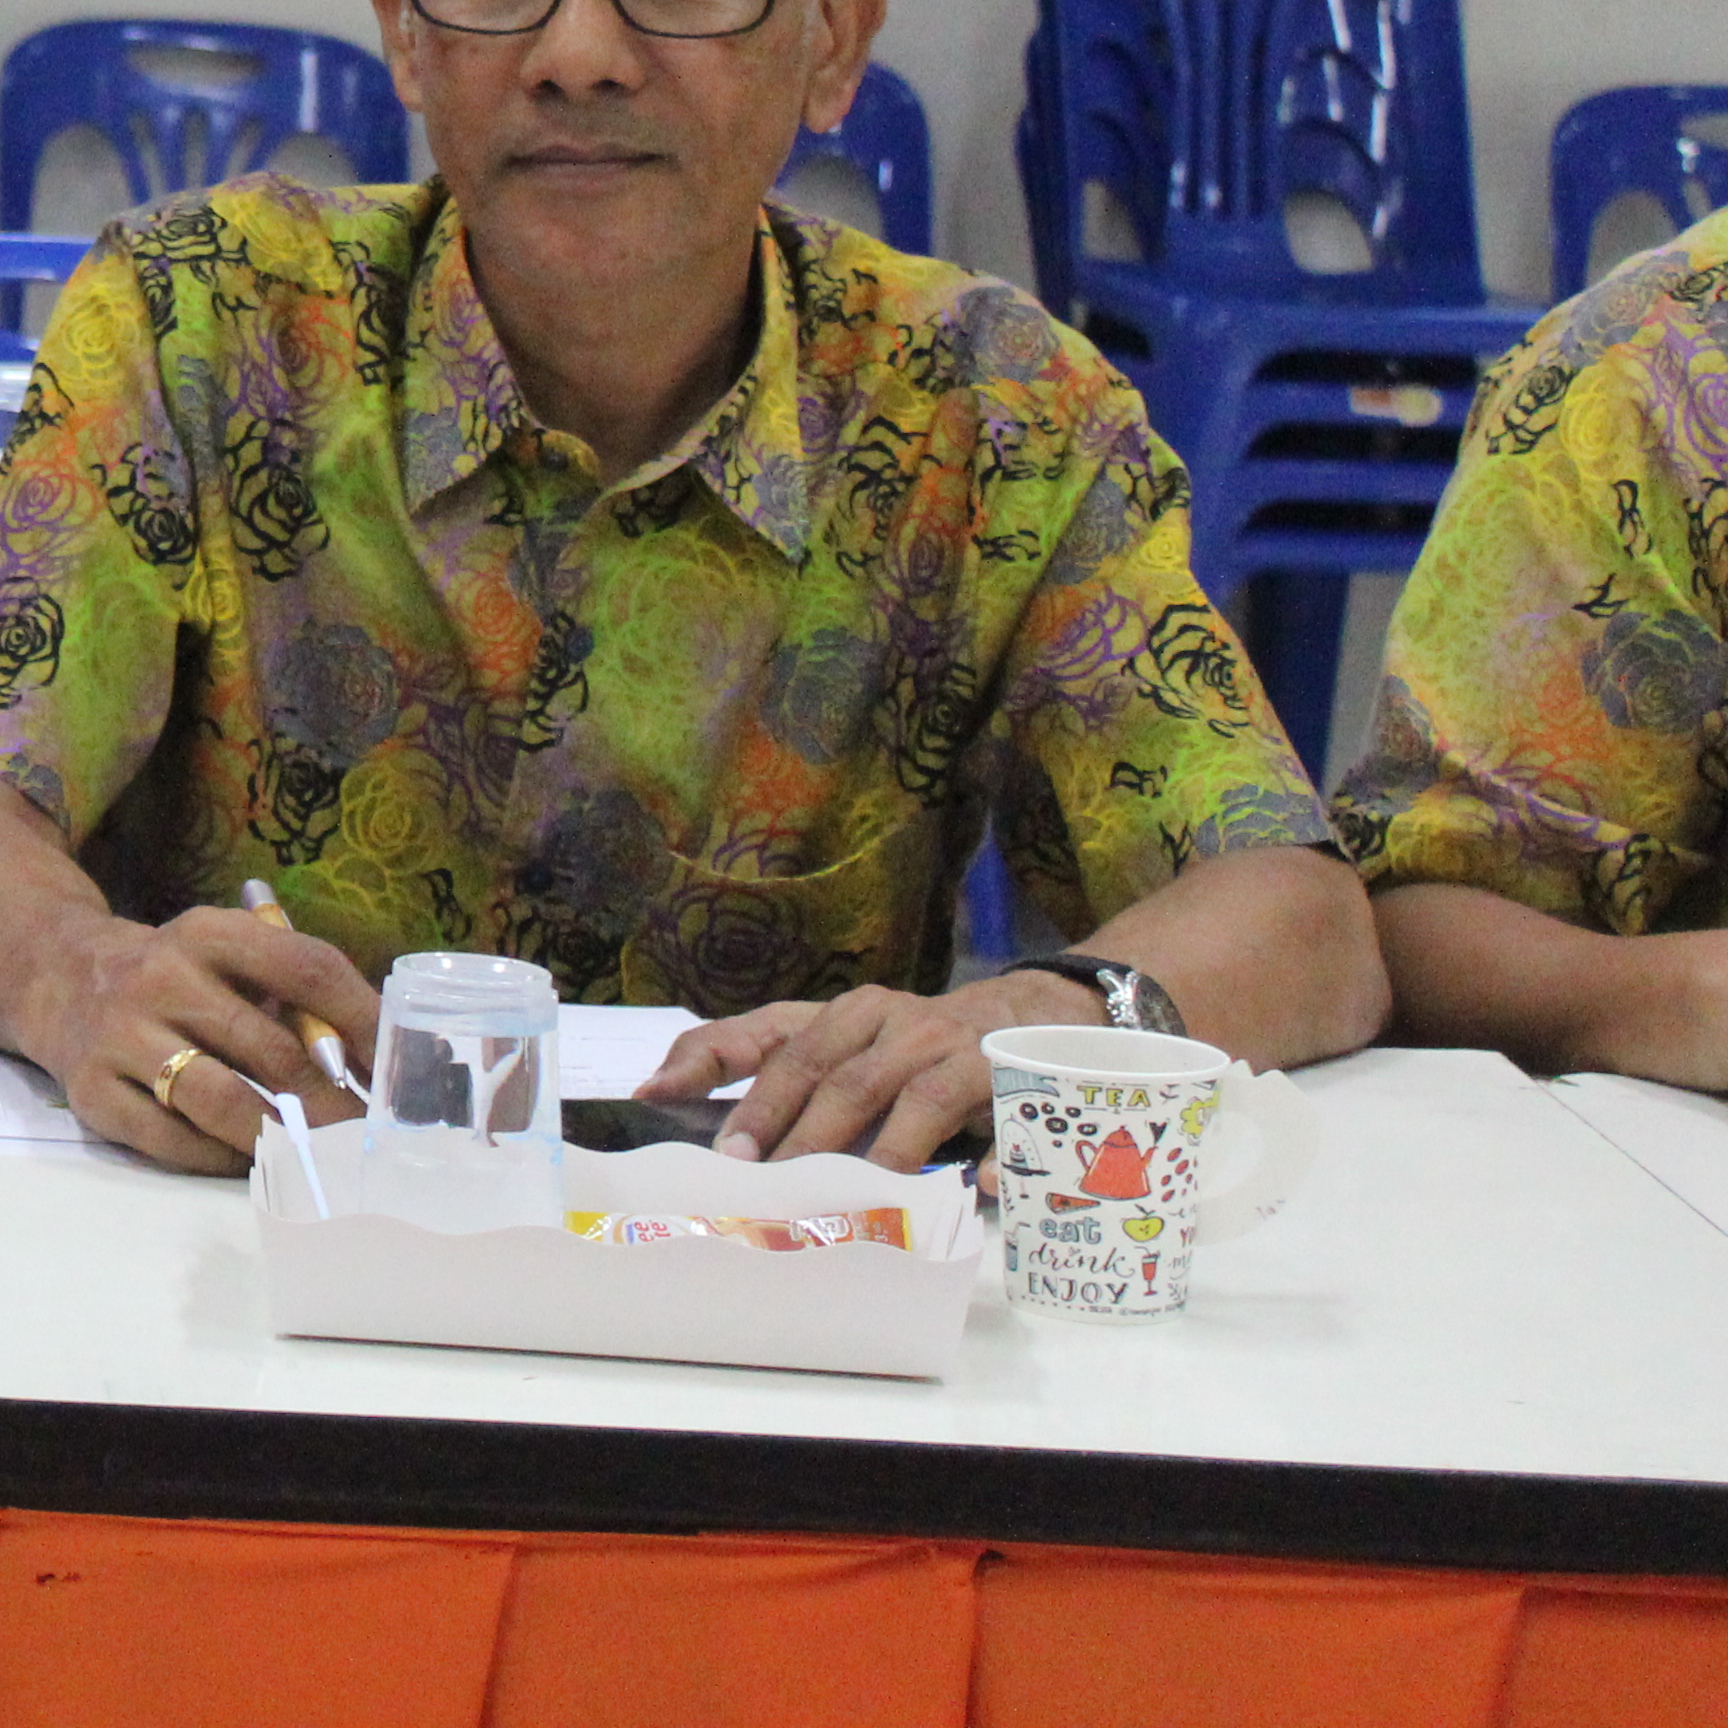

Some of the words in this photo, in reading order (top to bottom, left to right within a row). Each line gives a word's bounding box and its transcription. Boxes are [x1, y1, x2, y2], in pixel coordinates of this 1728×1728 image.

[1076, 1085, 1151, 1108] TEA
[1038, 1216, 1102, 1245] eat
[1028, 1241, 1136, 1279] drink
[1028, 1271, 1128, 1304] ENJOY
